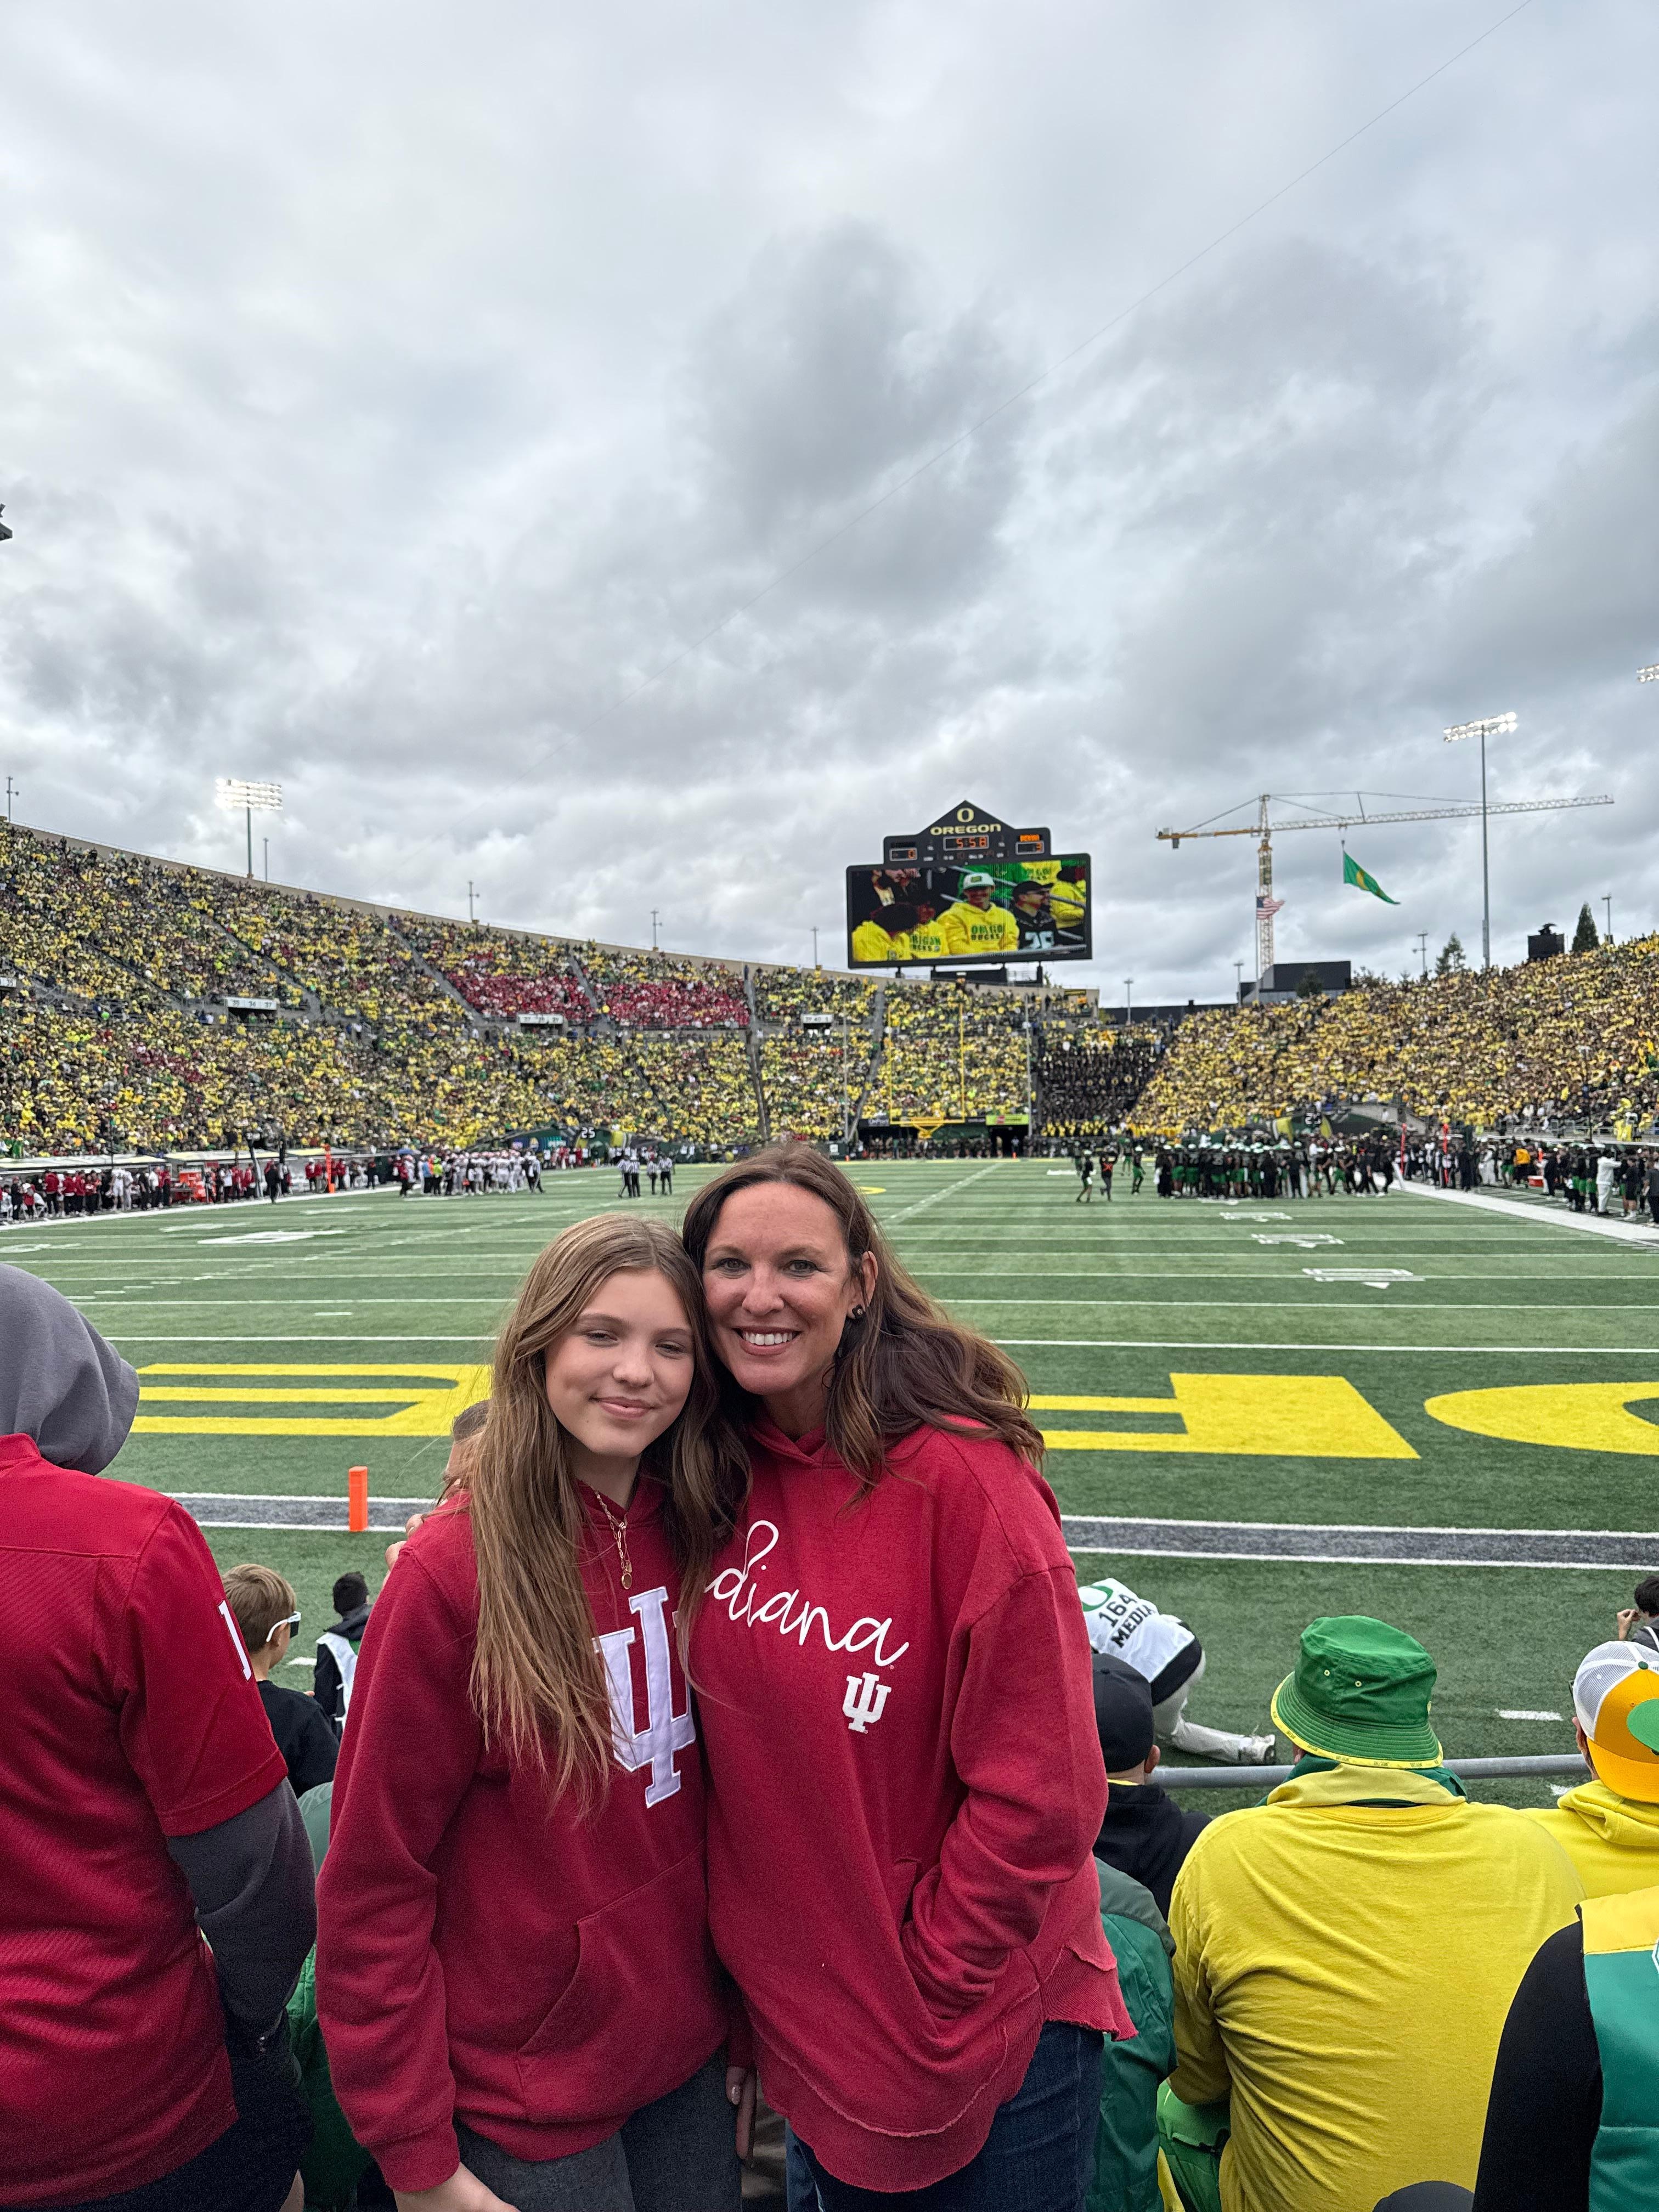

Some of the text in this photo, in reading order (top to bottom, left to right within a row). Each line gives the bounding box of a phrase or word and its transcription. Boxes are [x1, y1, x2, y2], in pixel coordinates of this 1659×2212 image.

[957, 808, 974, 822] O
[930, 823, 1001, 836] OREGON
[581, 1127, 595, 1138] 25
[704, 1520, 910, 1667] diana
[1099, 1594, 1137, 1628] 164
[1111, 1604, 1156, 1649] MEDIA
